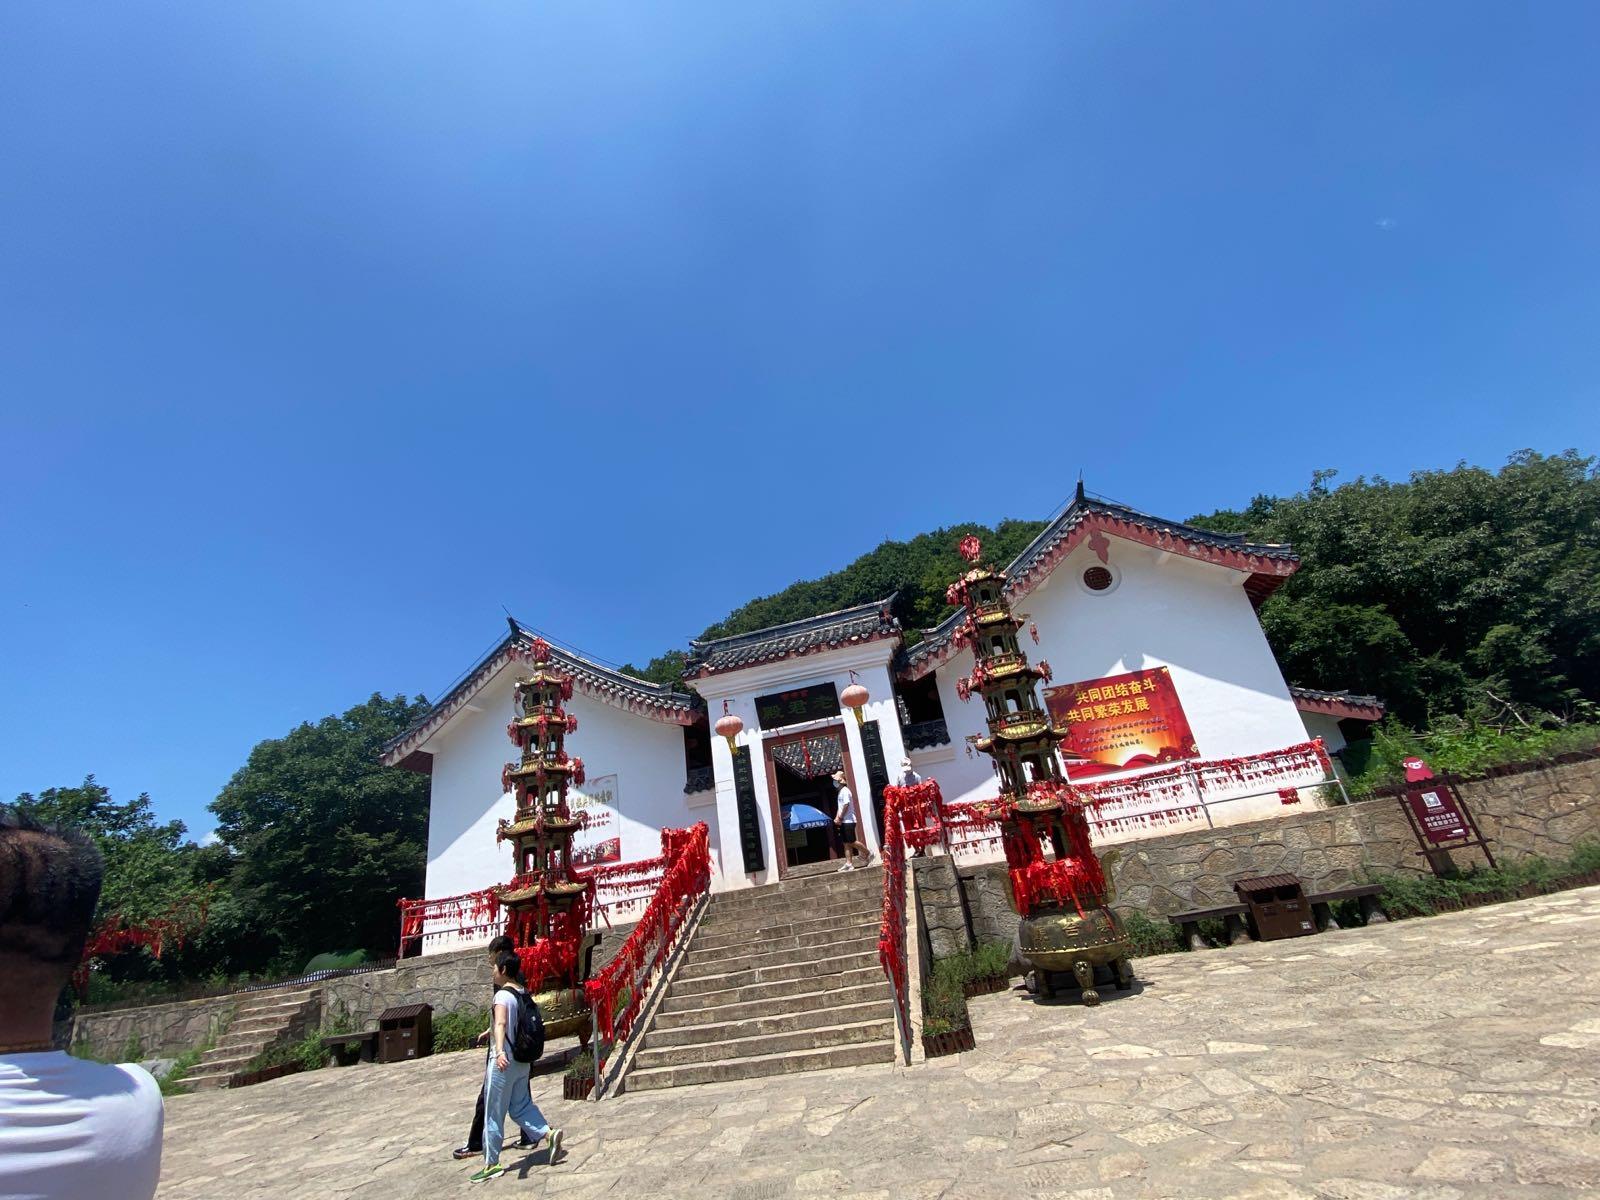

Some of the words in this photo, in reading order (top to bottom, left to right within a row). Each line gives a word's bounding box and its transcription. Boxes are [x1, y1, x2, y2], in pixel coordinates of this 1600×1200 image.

[1075, 677, 1157, 705] 共同团结奋斗
[1067, 697, 1151, 723] 共同繁荣发展
